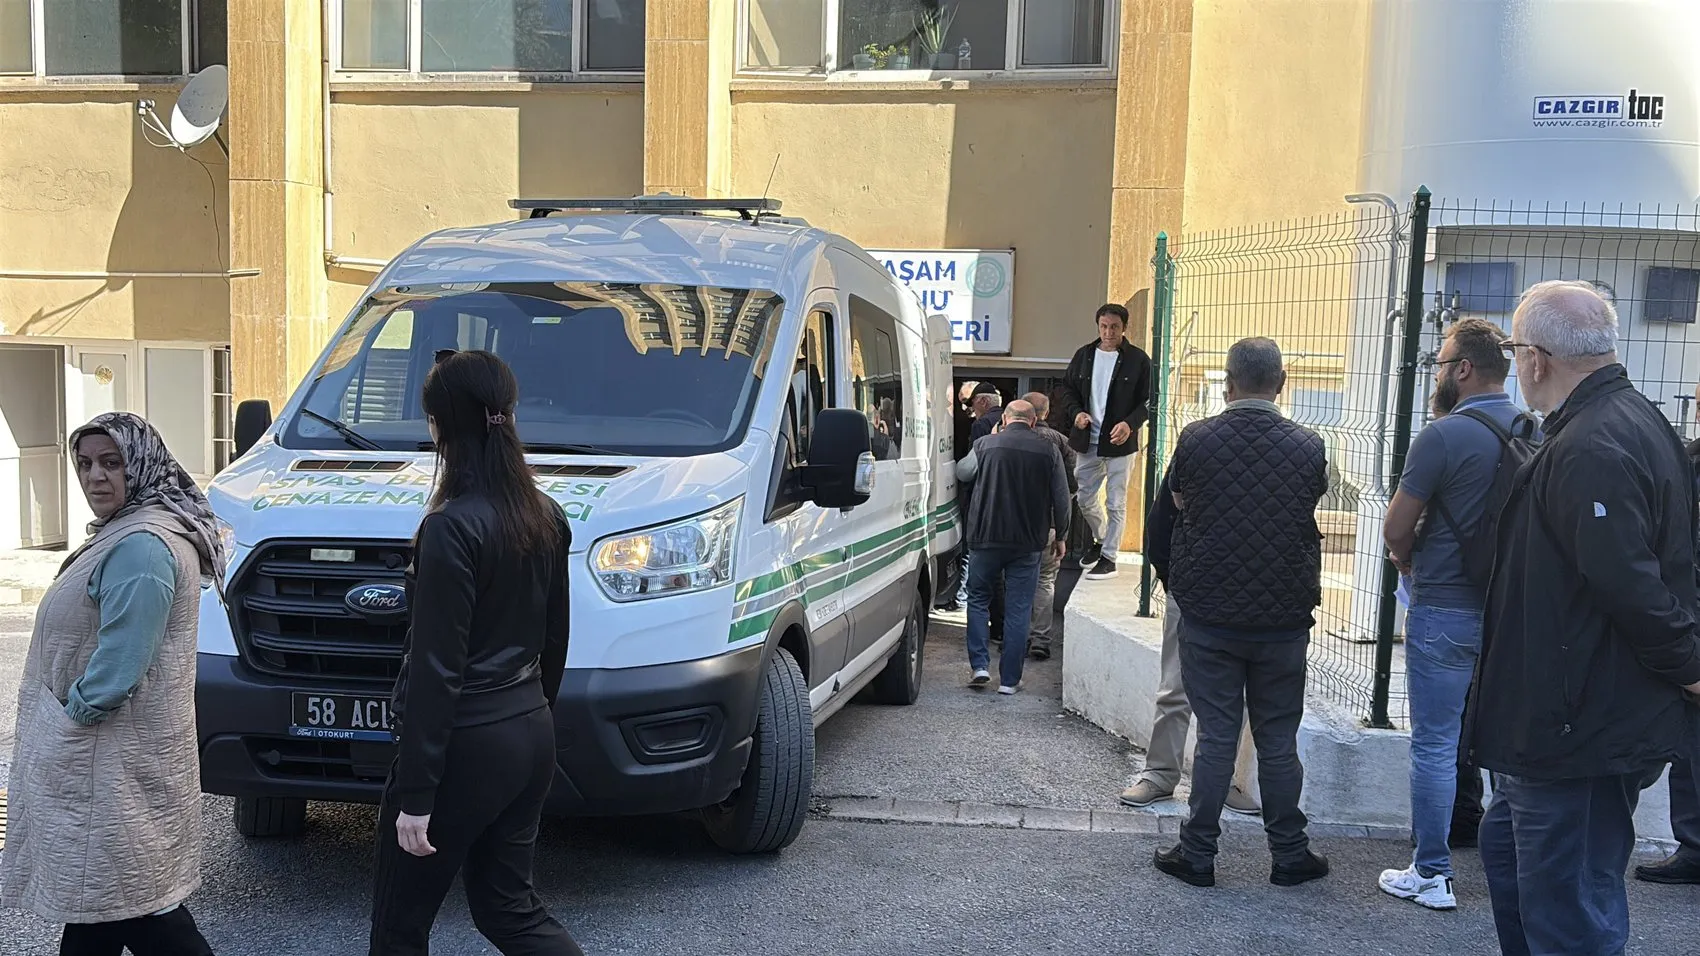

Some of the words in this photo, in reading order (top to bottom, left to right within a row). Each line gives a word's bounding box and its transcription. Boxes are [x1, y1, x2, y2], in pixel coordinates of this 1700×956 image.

[1538, 100, 1619, 114] CAZGIR
[1628, 89, 1664, 120] toc
[1533, 119, 1662, 128] www.cazgir.com.tr
[879, 259, 956, 287] AŞAM
[950, 315, 990, 342] ERİ
[269, 474, 372, 490] SİVAS
[252, 490, 378, 511] CENAZE
[359, 588, 401, 606] Ford
[307, 697, 336, 726] 58
[317, 730, 355, 739] OTOKURT
